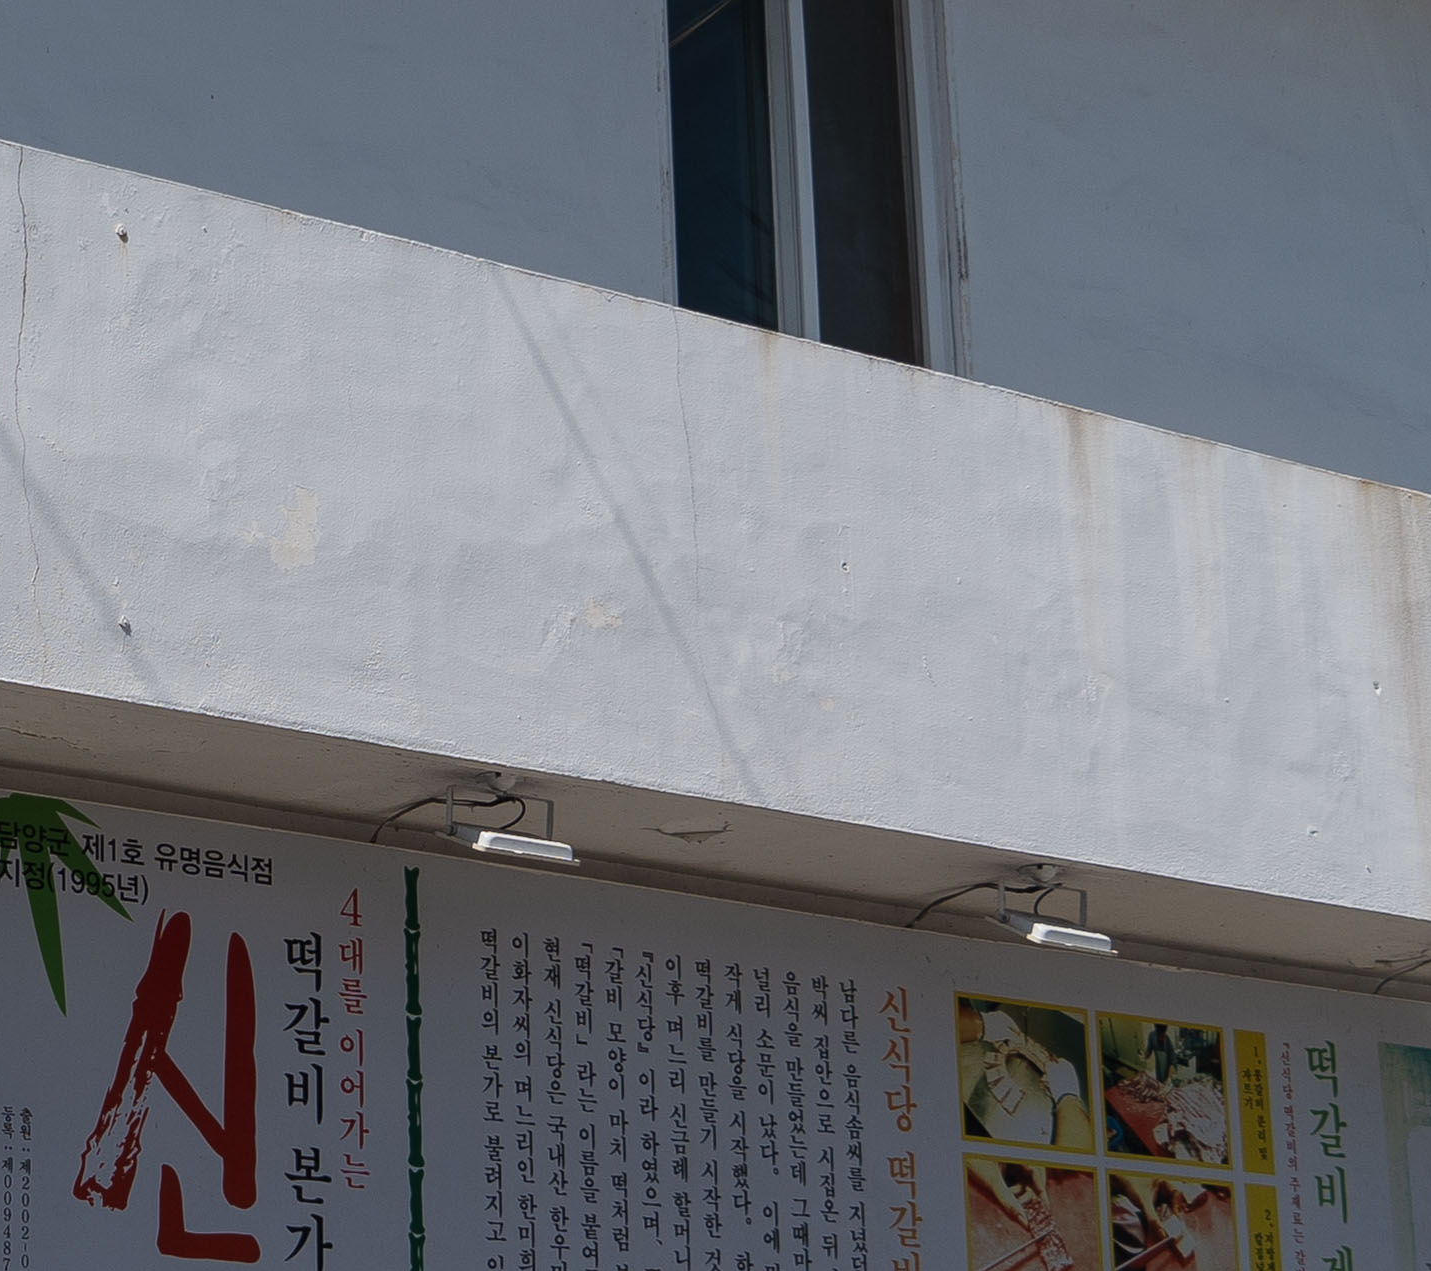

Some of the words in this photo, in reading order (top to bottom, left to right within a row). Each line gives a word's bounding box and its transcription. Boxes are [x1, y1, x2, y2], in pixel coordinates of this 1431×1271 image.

[82, 833, 144, 867] 제1호
[154, 842, 273, 886] 유명음식점
[283, 931, 331, 1126] 떡갈비
[480, 928, 500, 1034] 떡갈비의
[512, 932, 532, 1066] 이화자씨의
[839, 980, 860, 1054] 남다른
[340, 1029, 370, 1189] 이어가는
[482, 1045, 504, 1123] 본가로
[879, 986, 918, 1132] 신식당
[515, 1076, 536, 1183] 며느리인
[843, 1064, 866, 1192] 음식솜씨를
[1305, 1041, 1350, 1224] 떡갈비
[484, 1135, 506, 1242] 불려지고
